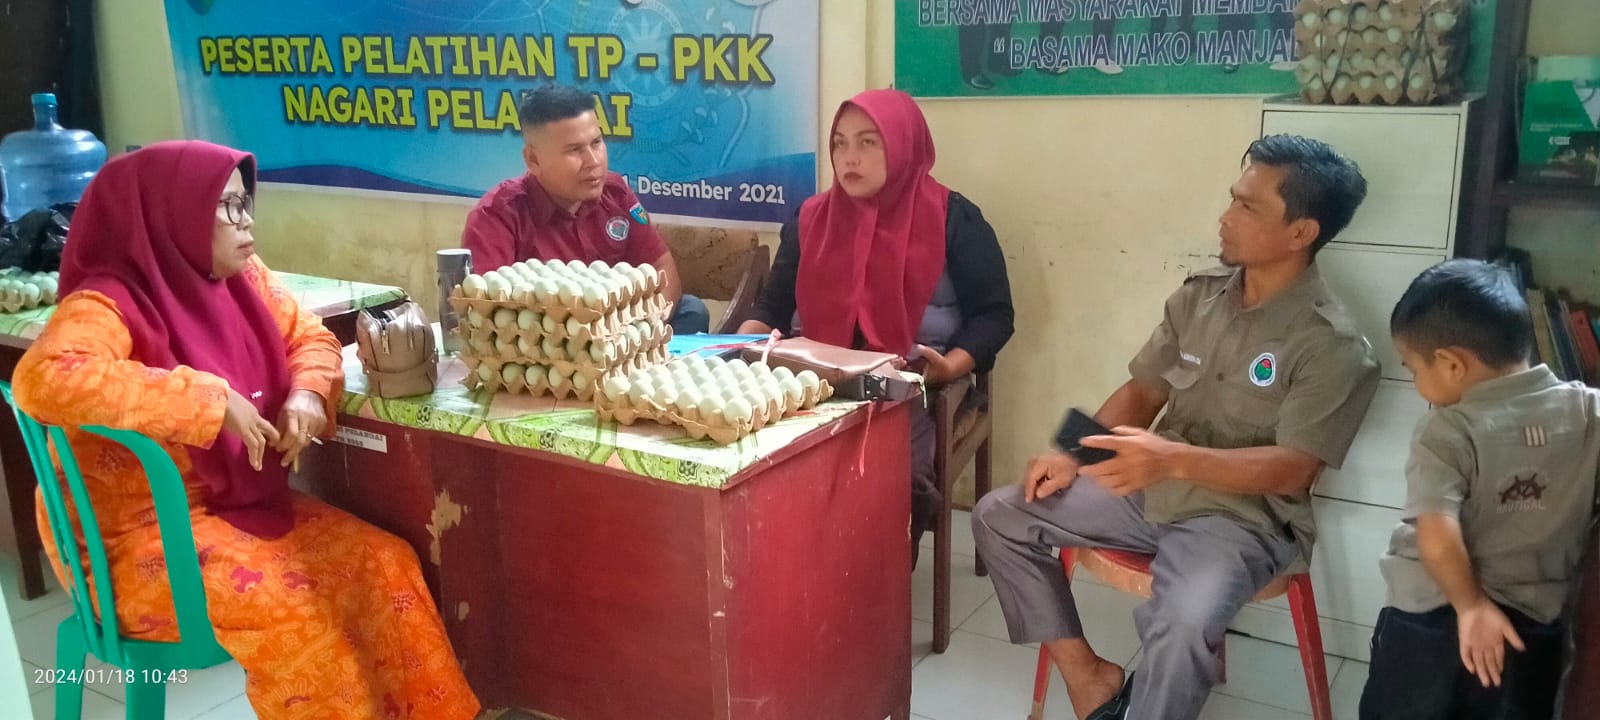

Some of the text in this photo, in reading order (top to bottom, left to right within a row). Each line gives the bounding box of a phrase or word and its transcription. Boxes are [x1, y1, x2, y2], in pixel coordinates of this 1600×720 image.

[918, 0, 1023, 26] BERSAMA
[199, 36, 334, 74] PESERTA
[341, 35, 556, 78] PELATIHAN
[567, 35, 624, 79] TP
[673, 35, 774, 83] PKK
[1010, 34, 1110, 70] BASAMA
[1114, 31, 1191, 67] MAKO
[282, 84, 633, 136] NAGARI PELAAI
[637, 176, 732, 200] Desember
[739, 183, 785, 205] 2021
